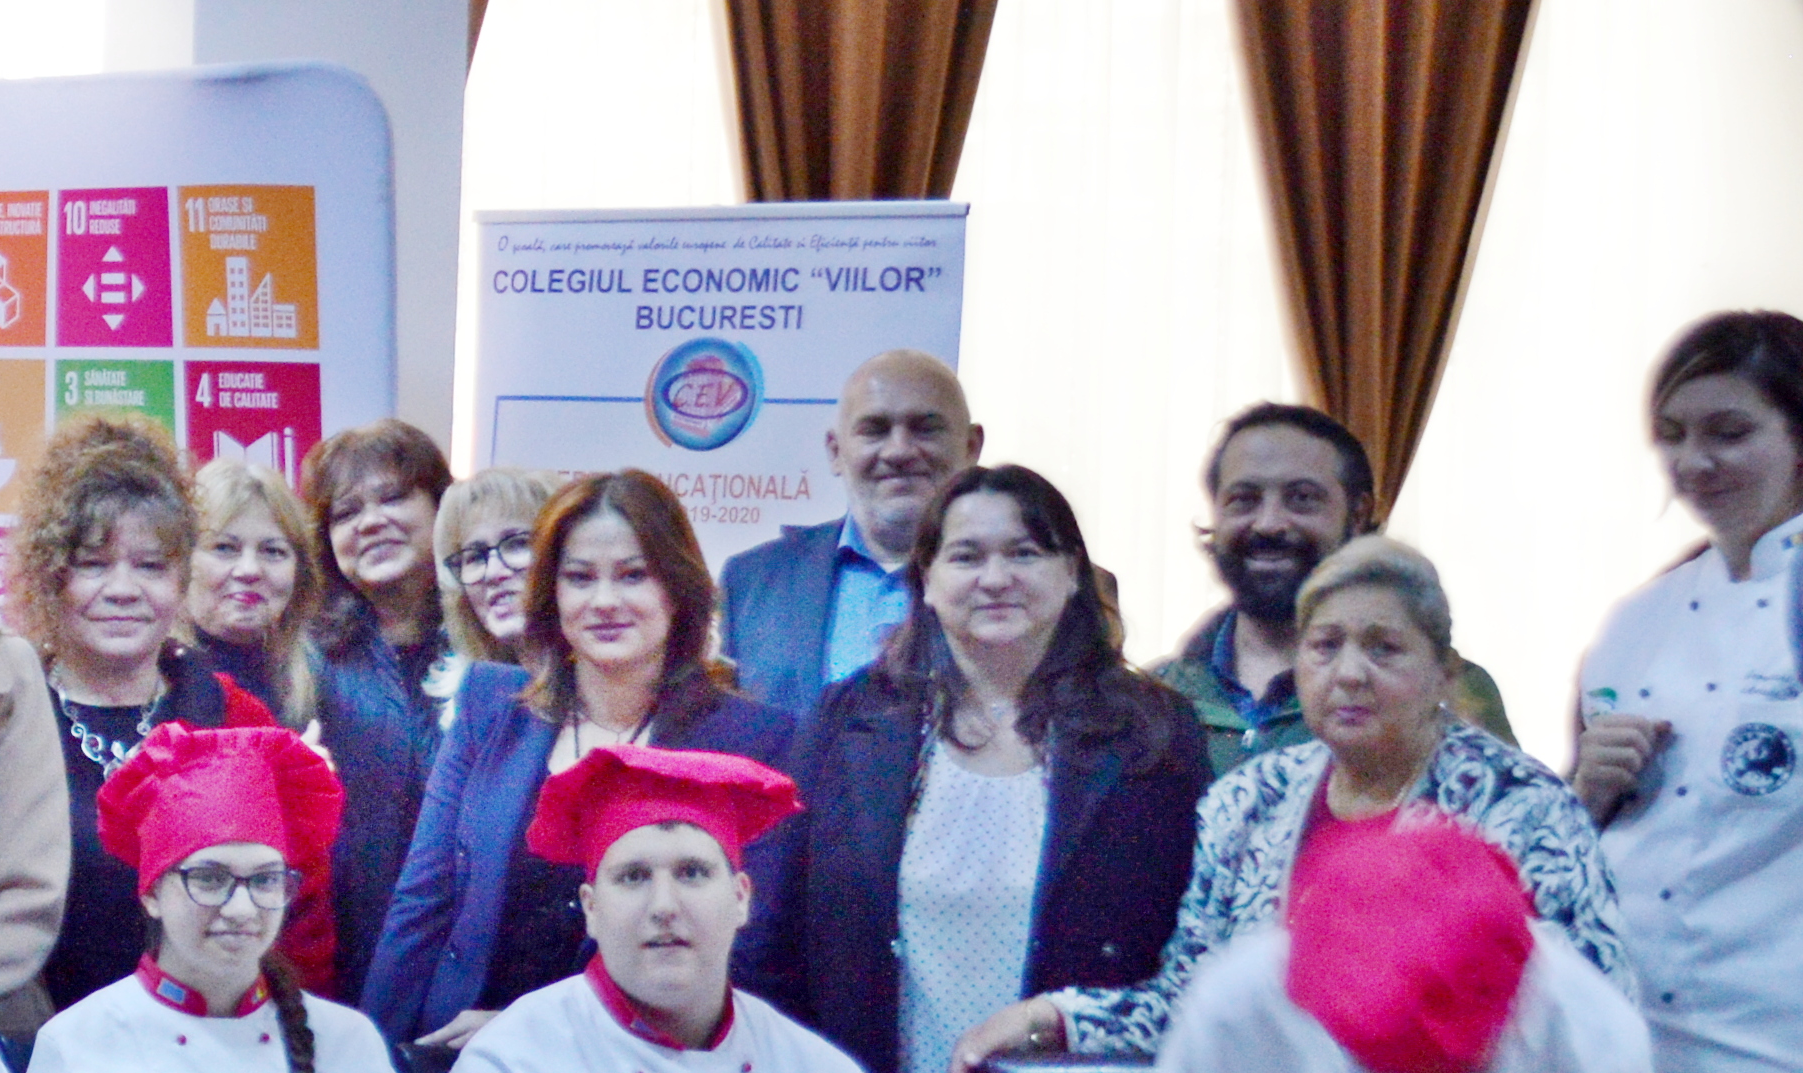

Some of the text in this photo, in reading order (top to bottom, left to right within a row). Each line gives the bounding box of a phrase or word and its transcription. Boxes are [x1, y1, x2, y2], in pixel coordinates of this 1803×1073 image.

[63, 201, 86, 235] 10
[185, 197, 206, 233] 11
[749, 236, 792, 250] Calitate
[493, 268, 632, 293] COLEGIUL
[642, 267, 800, 293] ECONOMIC
[635, 305, 804, 330] BUCURESTI
[64, 371, 78, 406] 3
[195, 372, 211, 408] 4
[219, 391, 279, 409] DE CALITATE
[690, 507, 761, 524] 19-2020
